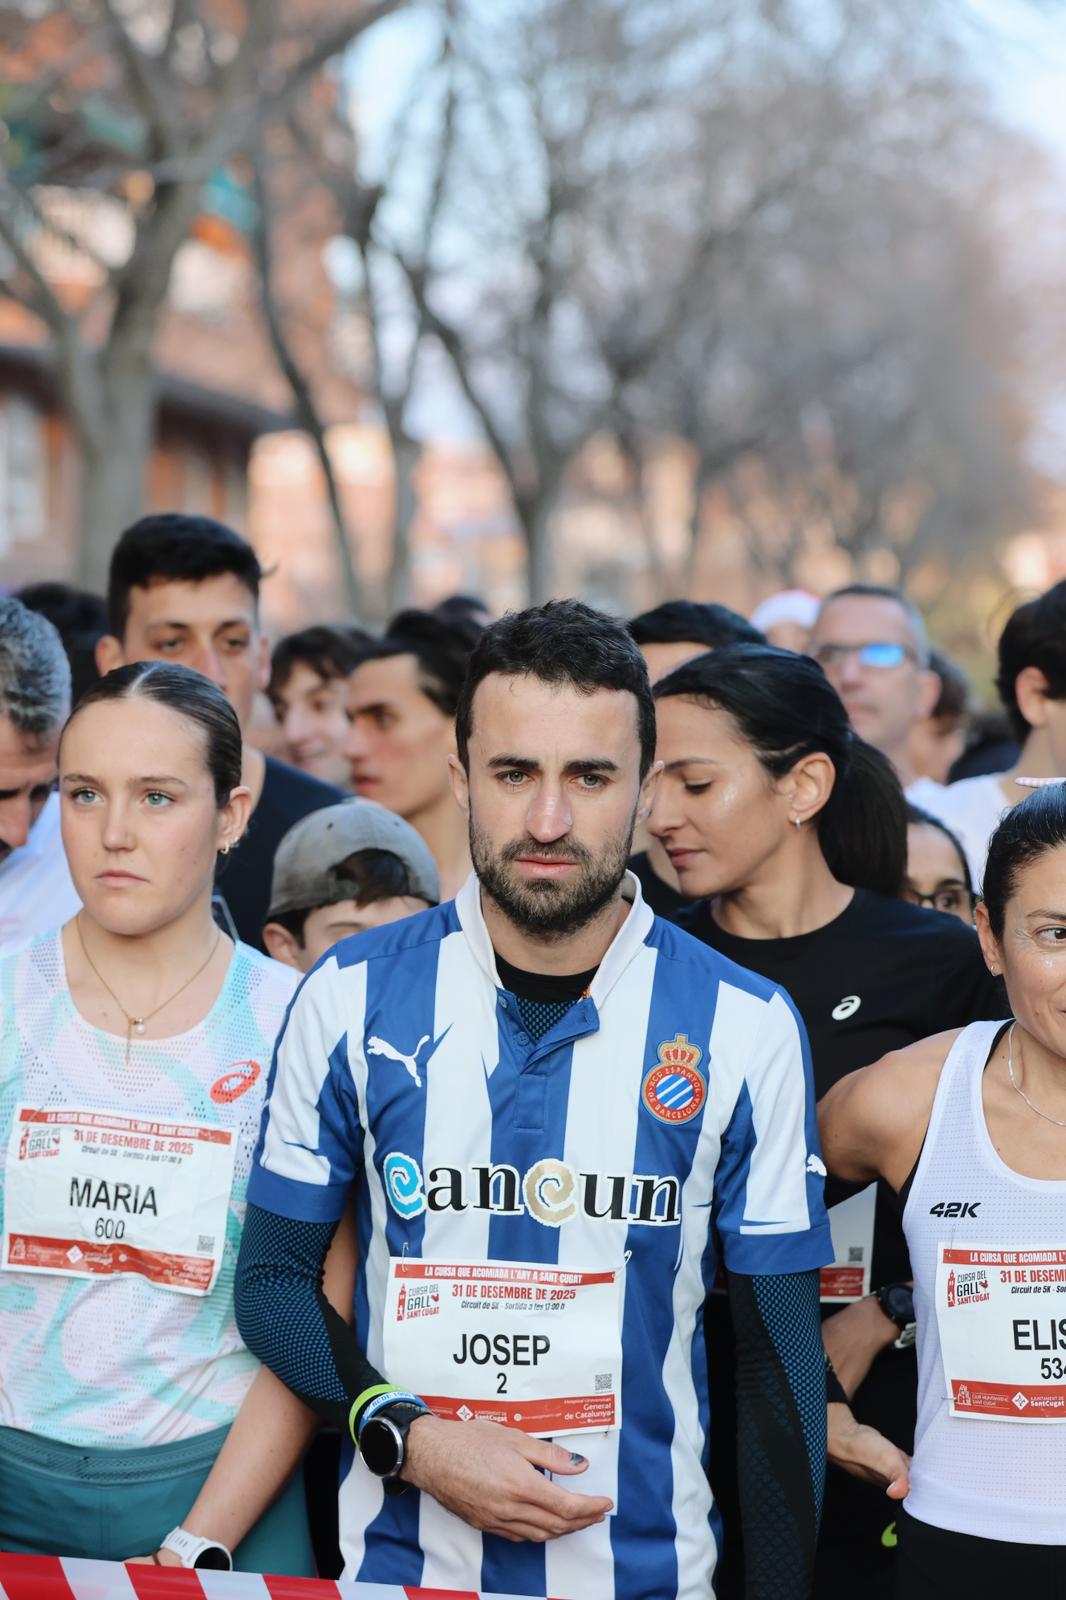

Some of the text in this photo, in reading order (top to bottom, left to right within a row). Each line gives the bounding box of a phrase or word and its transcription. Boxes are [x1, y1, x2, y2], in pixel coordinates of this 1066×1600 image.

[86, 1130, 98, 1143] DE
[101, 1132, 151, 1150] DESEMBRE
[154, 1140, 165, 1152] DE
[168, 1141, 194, 1156] 2025
[70, 1177, 158, 1216] MARIA
[929, 1202, 982, 1218] 42K
[95, 1217, 125, 1239] 600
[970, 1252, 978, 1262] LA
[980, 1253, 1001, 1263] CURSA
[1003, 1253, 1017, 1264] QUE
[1019, 1252, 1057, 1263] ACOMIADA
[424, 1266, 433, 1276] LA
[457, 1267, 472, 1278] QUE
[532, 1270, 539, 1281] A
[539, 1271, 558, 1282] SANT
[560, 1274, 583, 1284] CUGAT
[957, 1270, 986, 1283] CURSA DEL
[1000, 1269, 1066, 1283] 31 DE DESEM
[452, 1284, 576, 1300] 31 DE DESEMBRE DE 2025
[956, 1281, 980, 1297] GALL
[1011, 1285, 1032, 1294] Circuit
[1033, 1285, 1042, 1293] de
[1043, 1285, 1051, 1293] 5K
[407, 1295, 431, 1311] GALL
[461, 1300, 481, 1309] Circuit
[482, 1301, 491, 1309] de
[957, 1293, 990, 1305] SANT CUGAT
[453, 1333, 551, 1366] JOSEP
[1041, 1357, 1066, 1379] 53
[496, 1373, 508, 1394] 2
[583, 1402, 612, 1411] General
[1030, 1400, 1065, 1408] SantCugat
[575, 1410, 612, 1419] Catalunya
